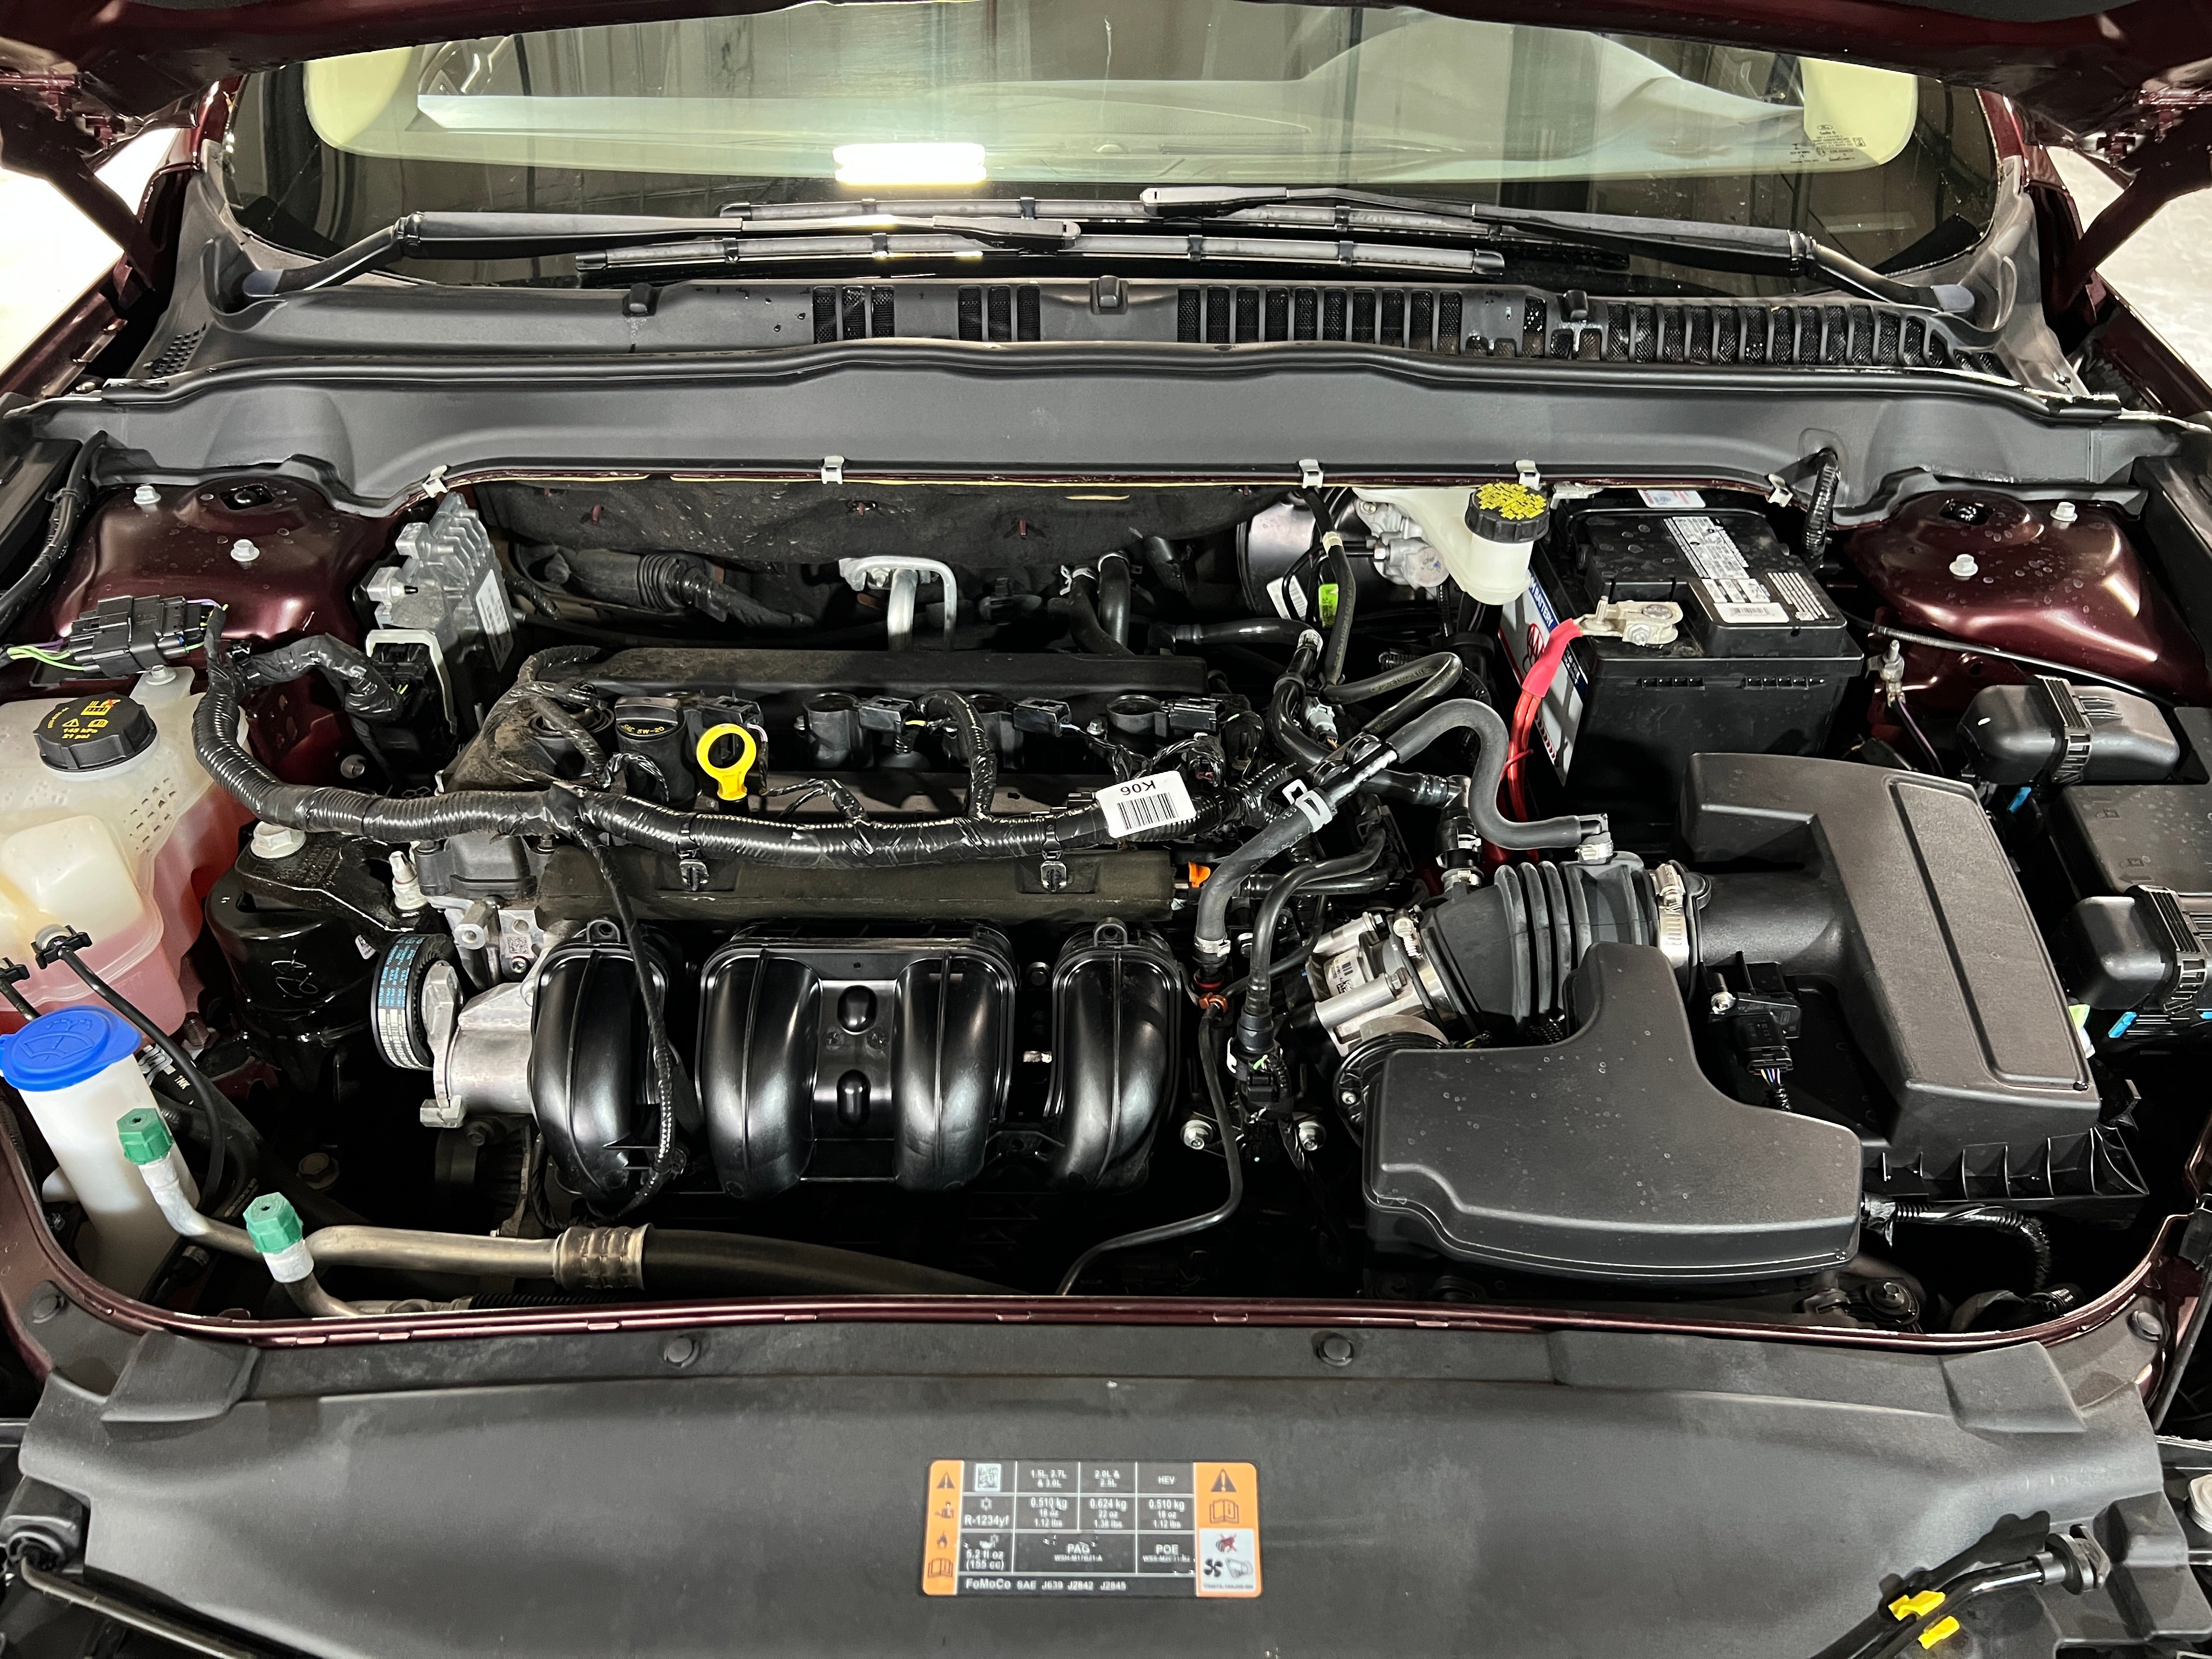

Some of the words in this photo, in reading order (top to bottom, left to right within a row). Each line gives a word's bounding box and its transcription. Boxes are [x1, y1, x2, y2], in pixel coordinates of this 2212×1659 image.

[1533, 590, 1554, 628] BATTERY
[1120, 780, 1156, 795] K06
[1051, 1469, 1066, 1479] 2.7L
[1094, 1470, 1111, 1479] 2.0L
[1114, 1470, 1120, 1479] &
[1038, 1479, 1043, 1488] &
[1046, 1479, 1062, 1488] 3.0L
[1100, 1479, 1116, 1487] 2.5L
[1158, 1476, 1175, 1485] HEV
[1031, 1497, 1053, 1508] 0.510
[1057, 1497, 1067, 1510] kg
[1090, 1498, 1113, 1509] 0.624
[1116, 1498, 1126, 1511] kg
[1149, 1499, 1172, 1509] 0.510
[1174, 1499, 1184, 1511] kg
[1098, 1510, 1107, 1519] 22
[964, 1514, 1009, 1528] R-1234yf
[1035, 1519, 1049, 1527] 1.12
[1051, 1519, 1063, 1528] lbs
[1111, 1519, 1122, 1528] lbs
[1154, 1520, 1167, 1528] 1.12
[1170, 1520, 1181, 1528] lbs
[1067, 1543, 1090, 1554] PAG
[1156, 1544, 1178, 1555] POE
[992, 1550, 1004, 1560] oz
[966, 1578, 1011, 1590] FoMoCo
[1017, 1580, 1036, 1590] SAE
